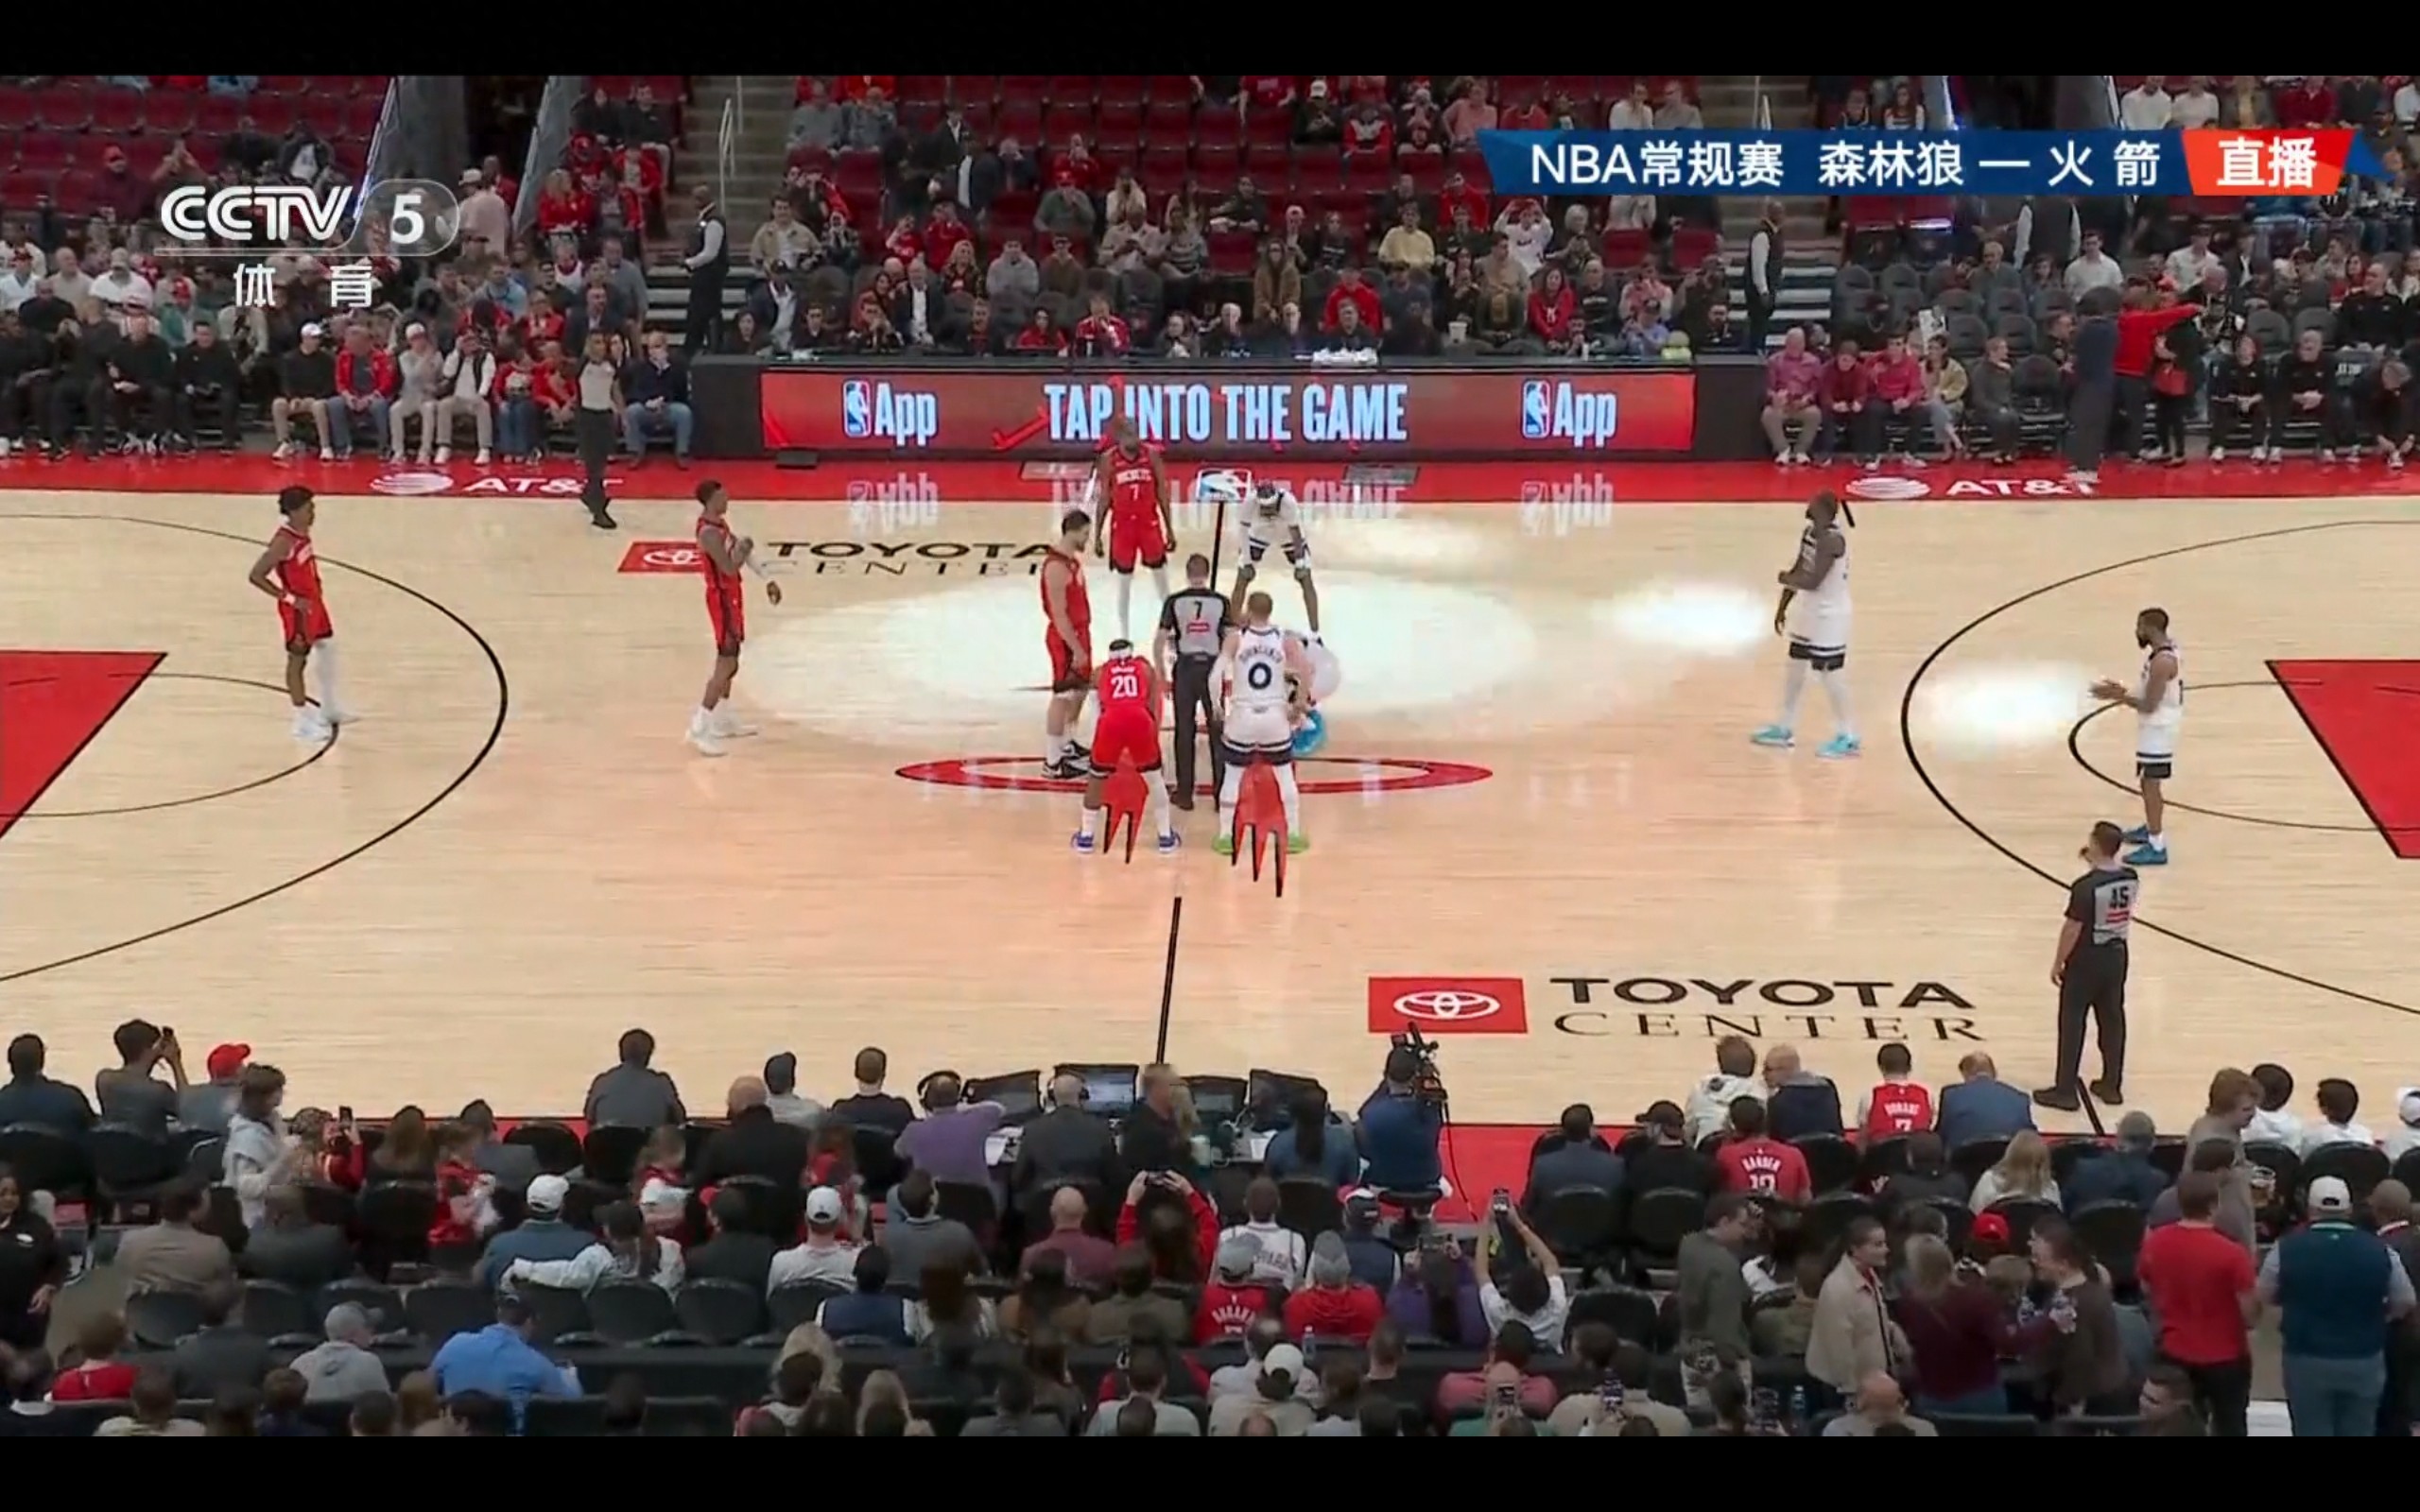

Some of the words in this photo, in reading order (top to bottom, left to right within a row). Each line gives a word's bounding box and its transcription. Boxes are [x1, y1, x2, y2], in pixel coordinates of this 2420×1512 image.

[873, 382, 937, 447] App
[1044, 384, 1114, 441] TAP
[1123, 384, 1211, 441] INTO
[1222, 384, 1292, 441] THE
[1302, 384, 1409, 442] GAME
[1551, 382, 1616, 448] App
[1130, 483, 1139, 502] 7
[767, 541, 1051, 559] TOYOTA
[759, 560, 1040, 576] CENTE
[1194, 601, 1203, 621] 7
[1110, 675, 1138, 698] 20
[1248, 662, 1272, 690] 0
[1550, 977, 1977, 1009] TOYOTA
[1553, 1012, 1985, 1041] CENTER
